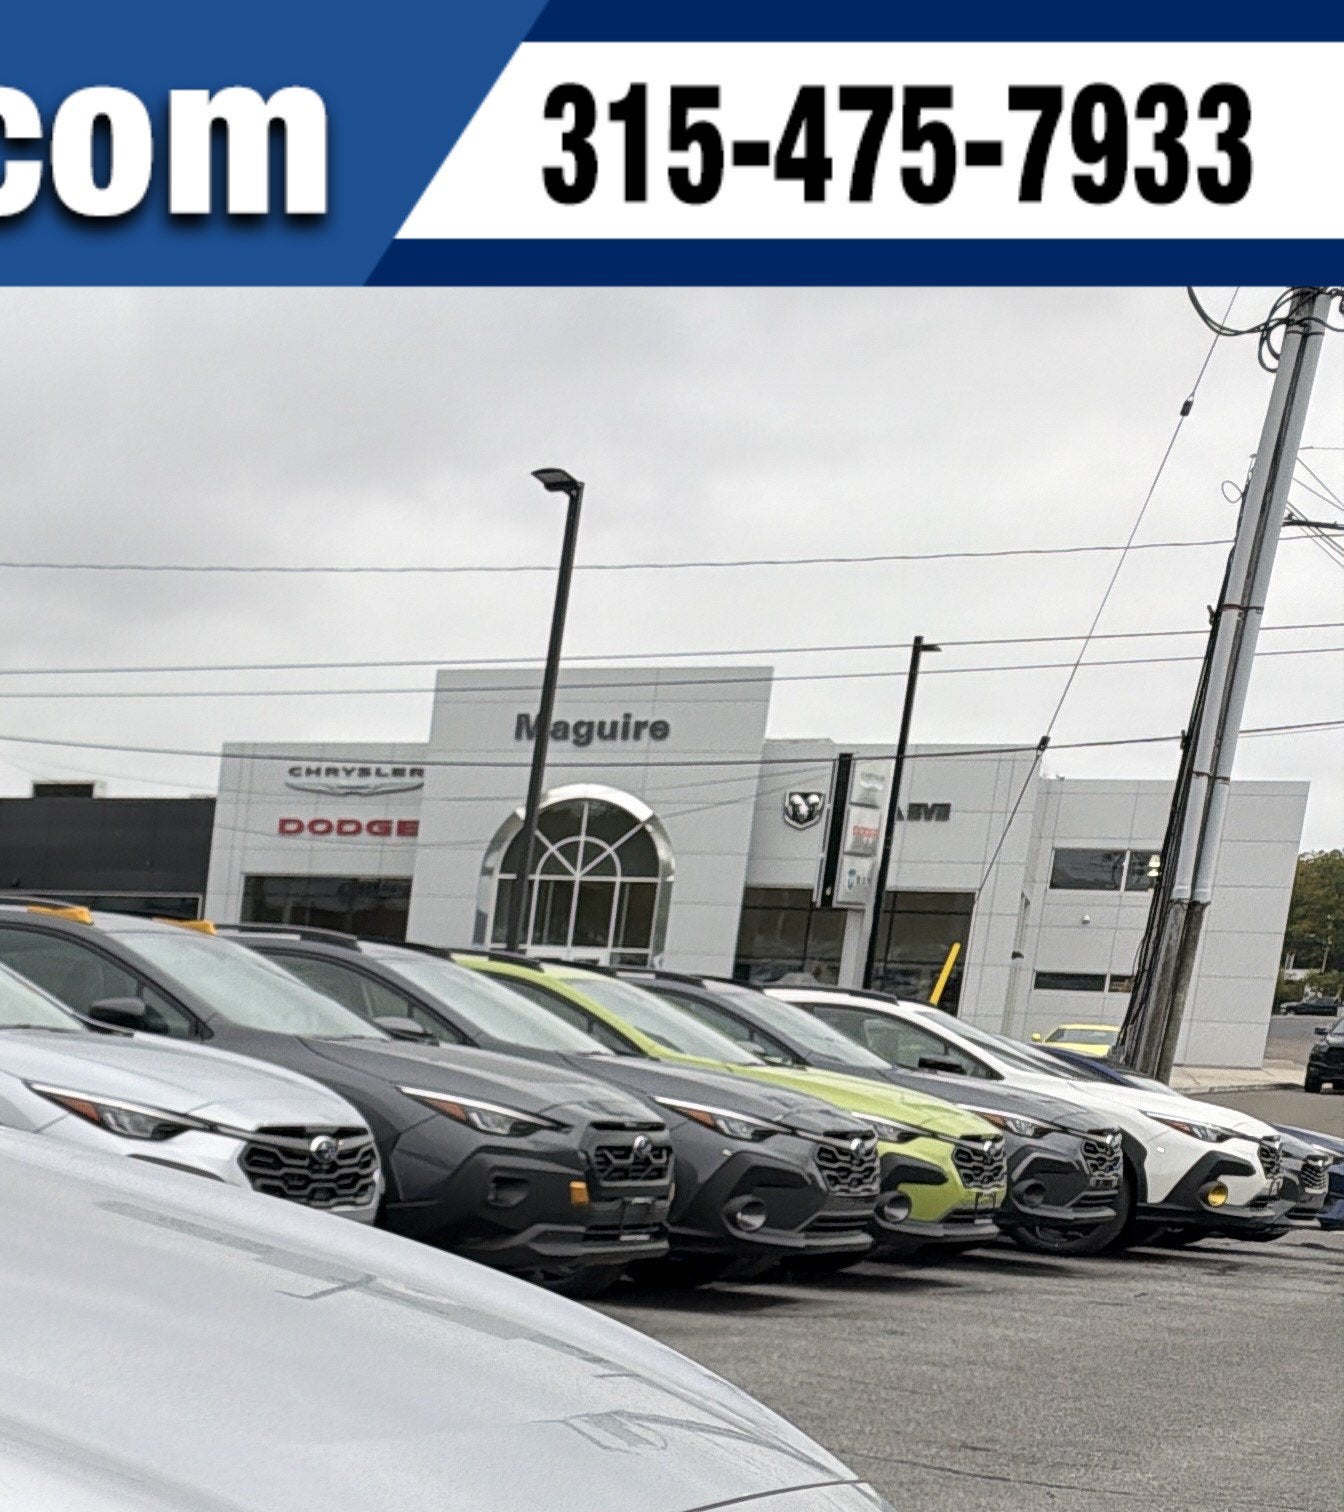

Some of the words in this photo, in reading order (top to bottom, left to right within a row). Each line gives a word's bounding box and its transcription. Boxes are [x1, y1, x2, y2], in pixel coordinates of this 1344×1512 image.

[514, 712, 670, 747] Maguire
[288, 766, 424, 778] CHRYSLER
[278, 818, 419, 837] DODGE
